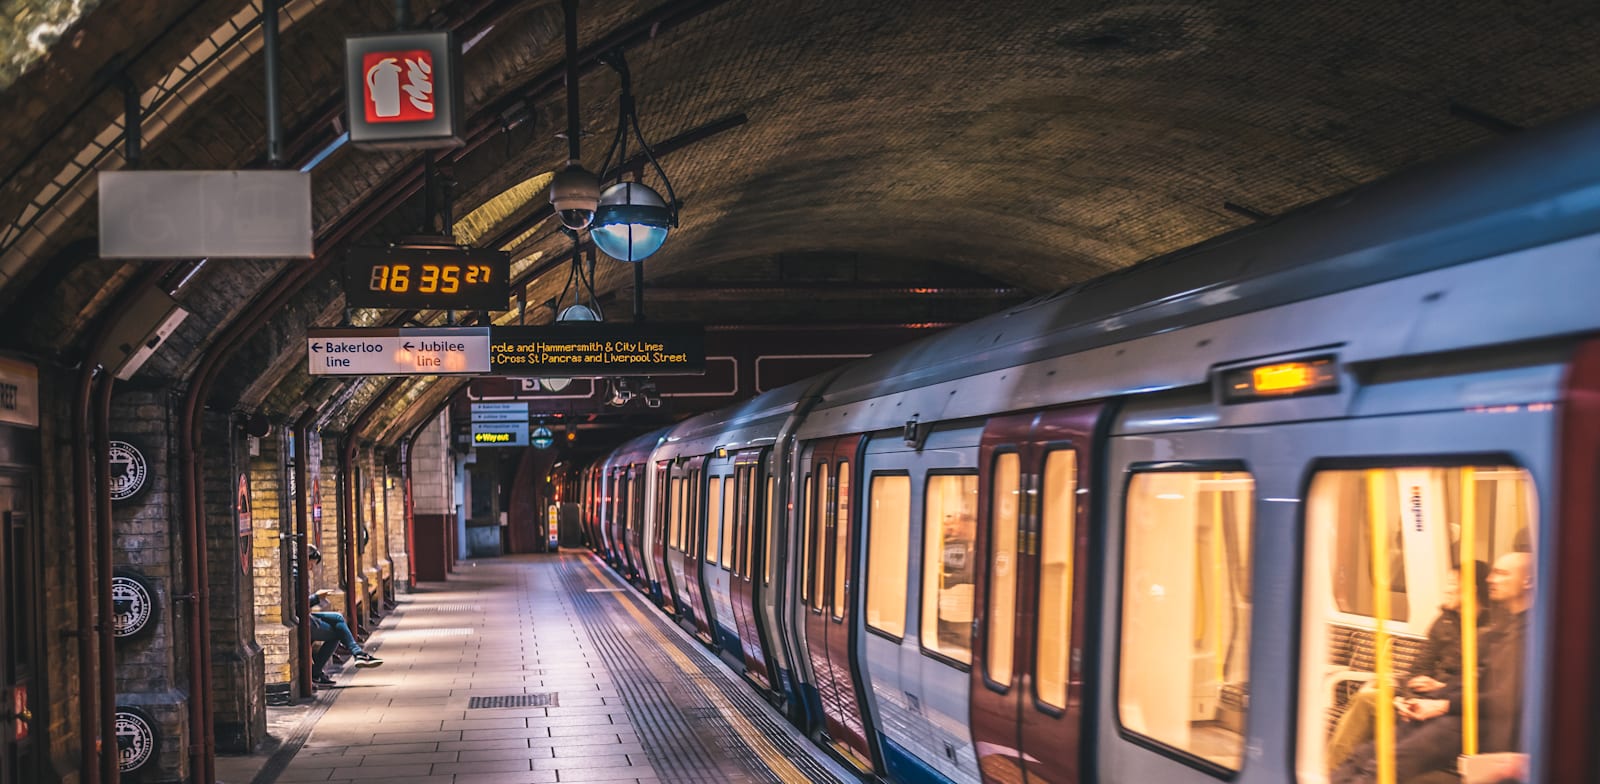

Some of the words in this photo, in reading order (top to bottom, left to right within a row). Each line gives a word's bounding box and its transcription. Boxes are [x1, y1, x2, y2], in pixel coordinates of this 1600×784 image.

[379, 264, 411, 293] 16
[418, 265, 461, 294] 35
[465, 265, 491, 284] 27
[326, 342, 383, 353] Bakerloo
[417, 341, 465, 352] Jubilee
[491, 343, 514, 353] rcle
[516, 342, 535, 353] and
[536, 341, 603, 352] Hammersmith
[604, 342, 614, 352] &
[615, 342, 637, 354] City
[638, 342, 664, 352] Lines
[326, 356, 350, 367] line
[417, 355, 441, 366] line
[497, 353, 526, 365] Cross
[528, 353, 540, 364] St
[541, 353, 582, 364] Pancras
[584, 353, 603, 363] and
[604, 353, 651, 364] Liverpool
[652, 353, 687, 363] Street
[0, 383, 17, 409] REET
[482, 433, 497, 442] Way
[497, 433, 510, 441] out
